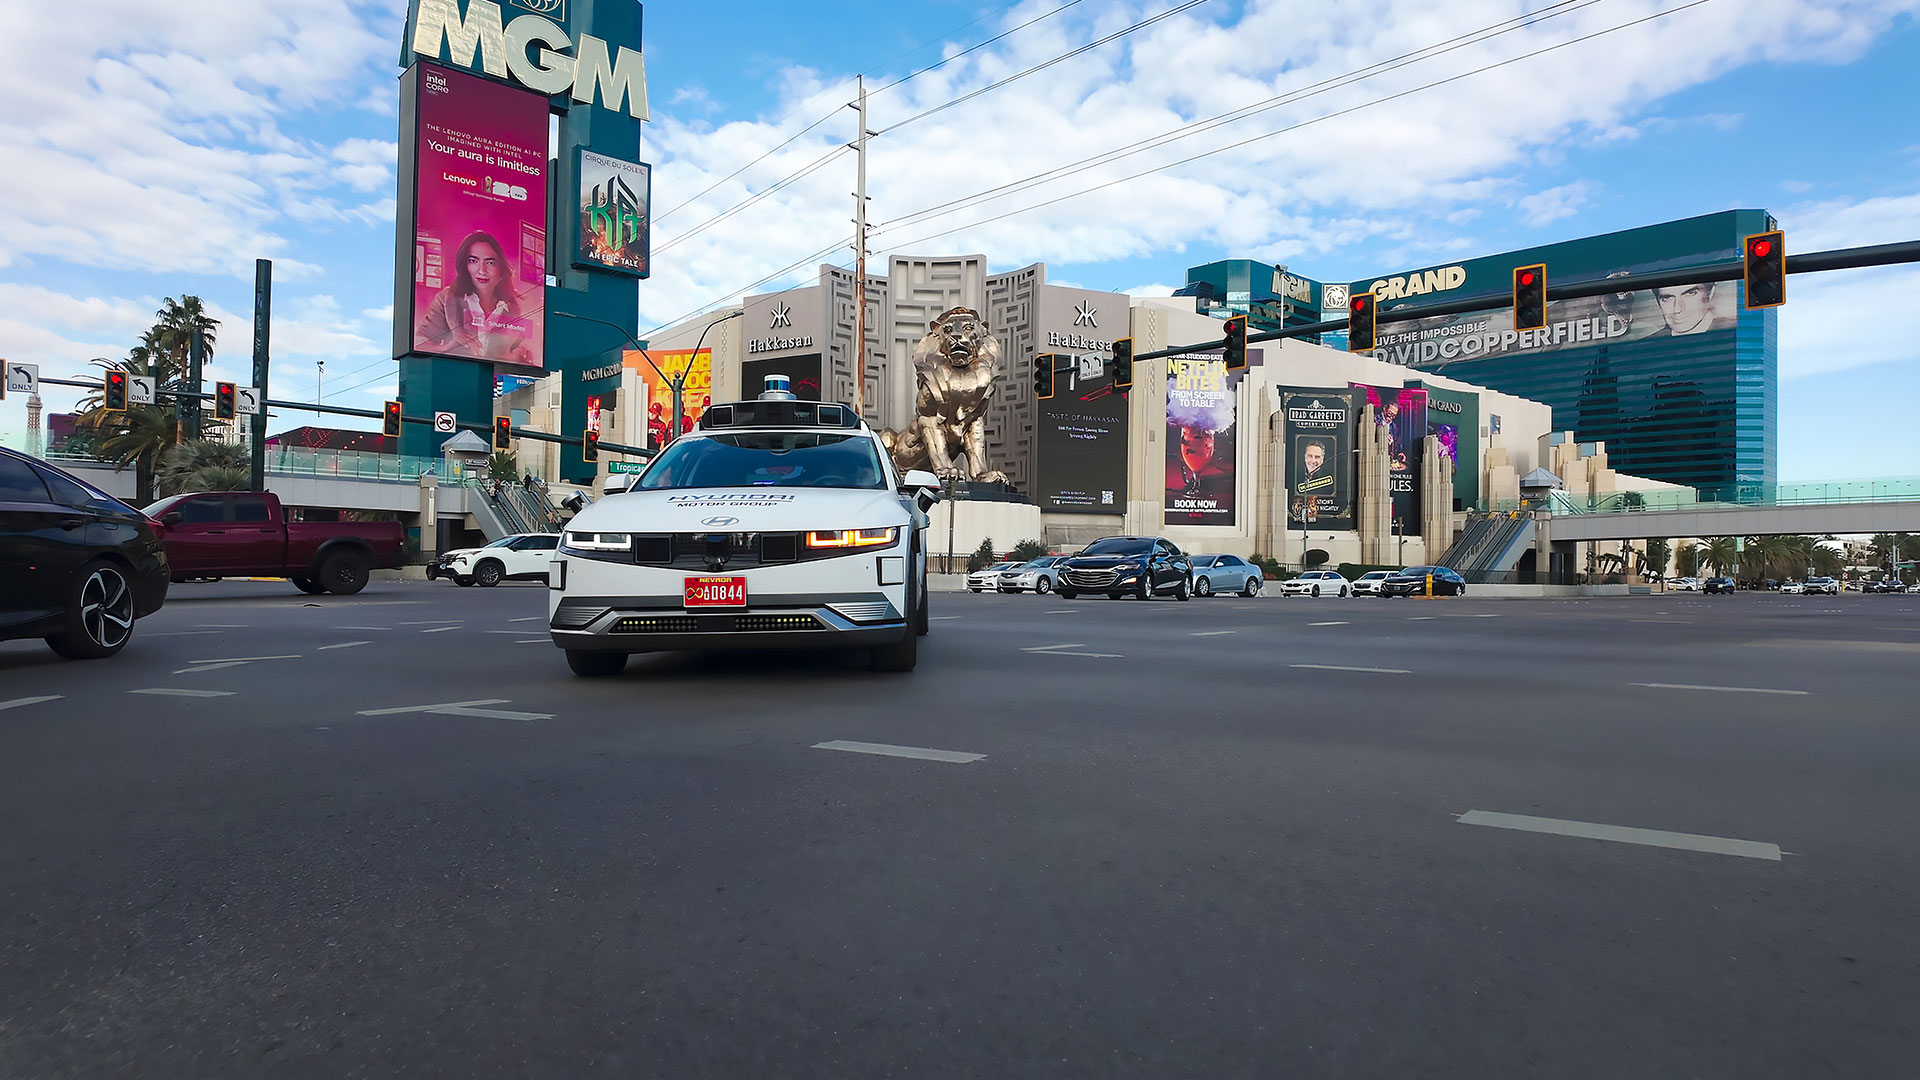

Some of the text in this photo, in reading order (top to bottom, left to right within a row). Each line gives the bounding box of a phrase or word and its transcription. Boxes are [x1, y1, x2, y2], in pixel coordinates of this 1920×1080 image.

[413, 0, 650, 121] MGM
[427, 123, 440, 132] THE
[443, 128, 472, 140] LENOVO
[473, 136, 493, 145] AURA
[495, 141, 522, 153] EDITION
[447, 136, 522, 159] IMAGINED WITH INTEL
[427, 139, 541, 176] Your aura is limitless
[585, 154, 611, 167] CIRQUE
[612, 161, 622, 169] DU
[443, 172, 477, 187] Lenovo
[589, 251, 639, 268] AN EPIC TALE
[1368, 265, 1466, 303] GRAND
[1398, 332, 1417, 343] THE
[1420, 320, 1486, 340] IMPOSSIBLE
[748, 335, 813, 353] Hakkasan
[1048, 331, 1113, 352] Hakkasa
[582, 368, 603, 382] MGM
[1168, 359, 1229, 377] NETFLIX
[1176, 374, 1219, 391] BITES
[1171, 390, 1225, 400] FROM SCREEN
[1179, 399, 1215, 408] TO TABLE
[1437, 400, 1462, 414] GRAND
[668, 493, 795, 502] HYUNDAI
[1174, 499, 1217, 509] BOOK NOW
